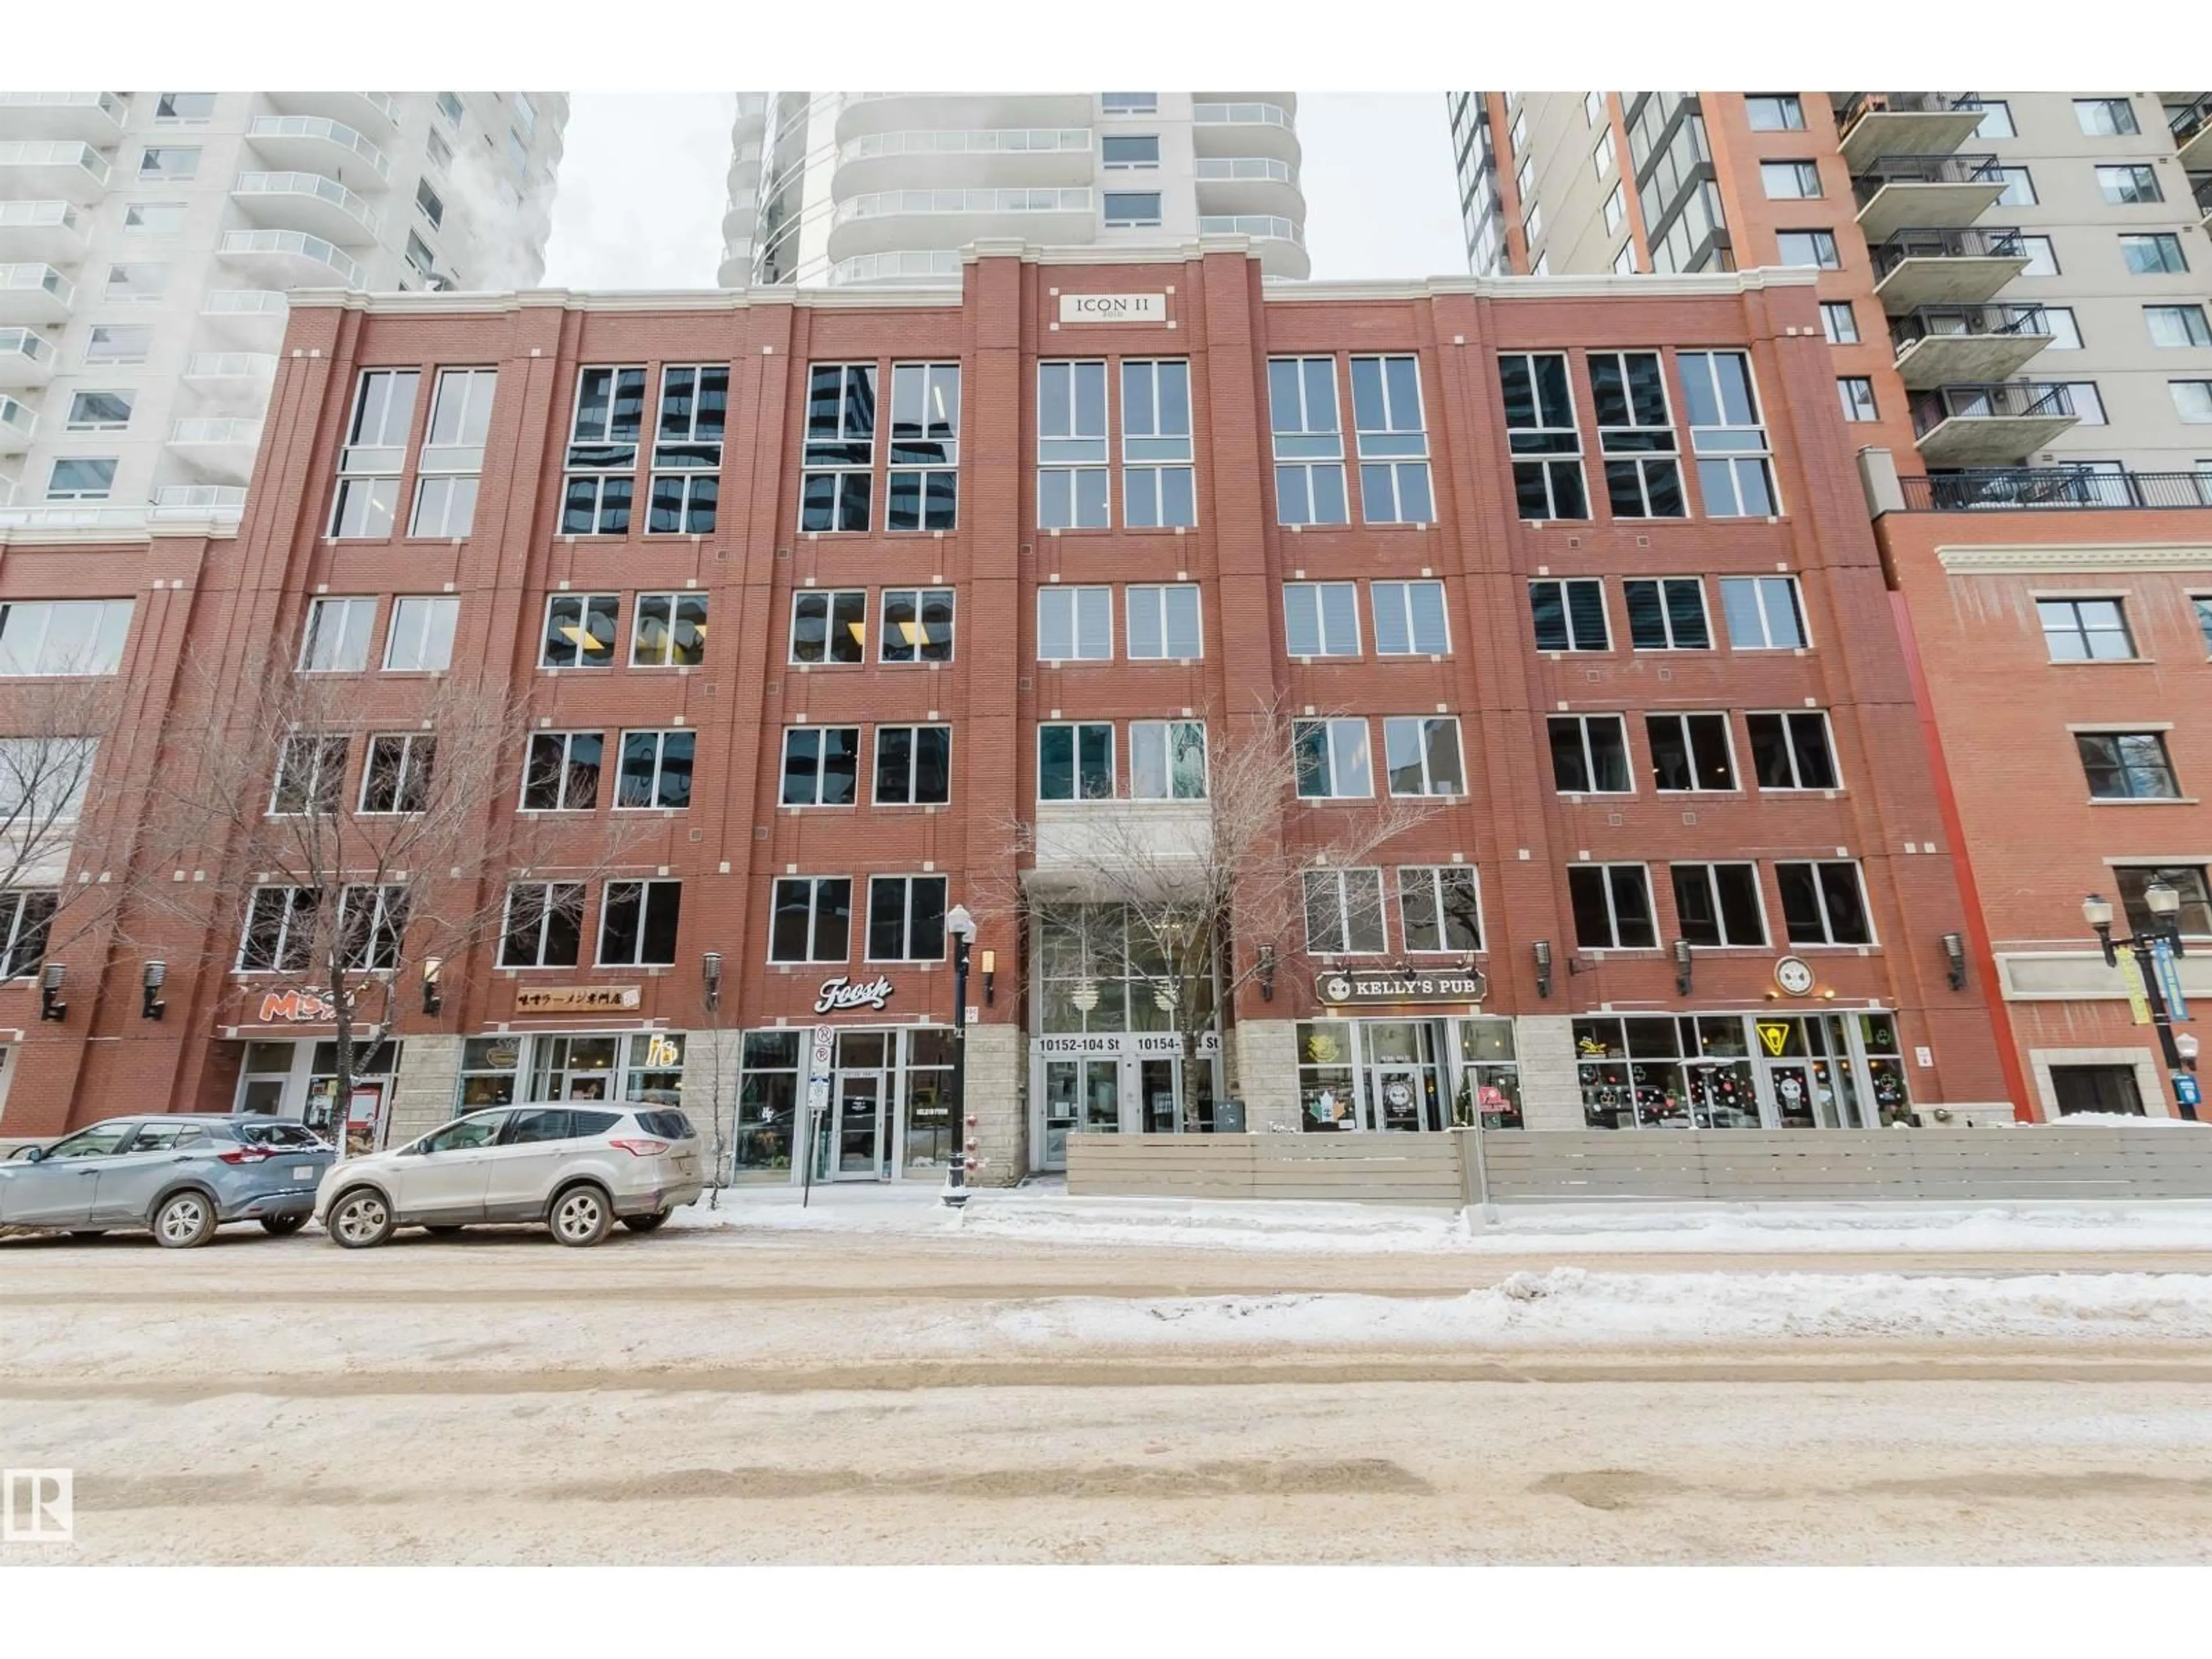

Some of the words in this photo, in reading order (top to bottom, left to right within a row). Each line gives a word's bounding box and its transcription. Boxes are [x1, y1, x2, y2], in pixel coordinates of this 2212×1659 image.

[1077, 299, 1127, 311] ICON
[1136, 298, 1148, 310] II
[814, 975, 892, 1012] Foosh
[1356, 980, 1433, 995] KELLY'S
[1440, 980, 1476, 993] PUB
[1040, 1039, 1103, 1051] 10152-104
[1107, 1039, 1120, 1050] St
[1207, 1037, 1218, 1048] St
